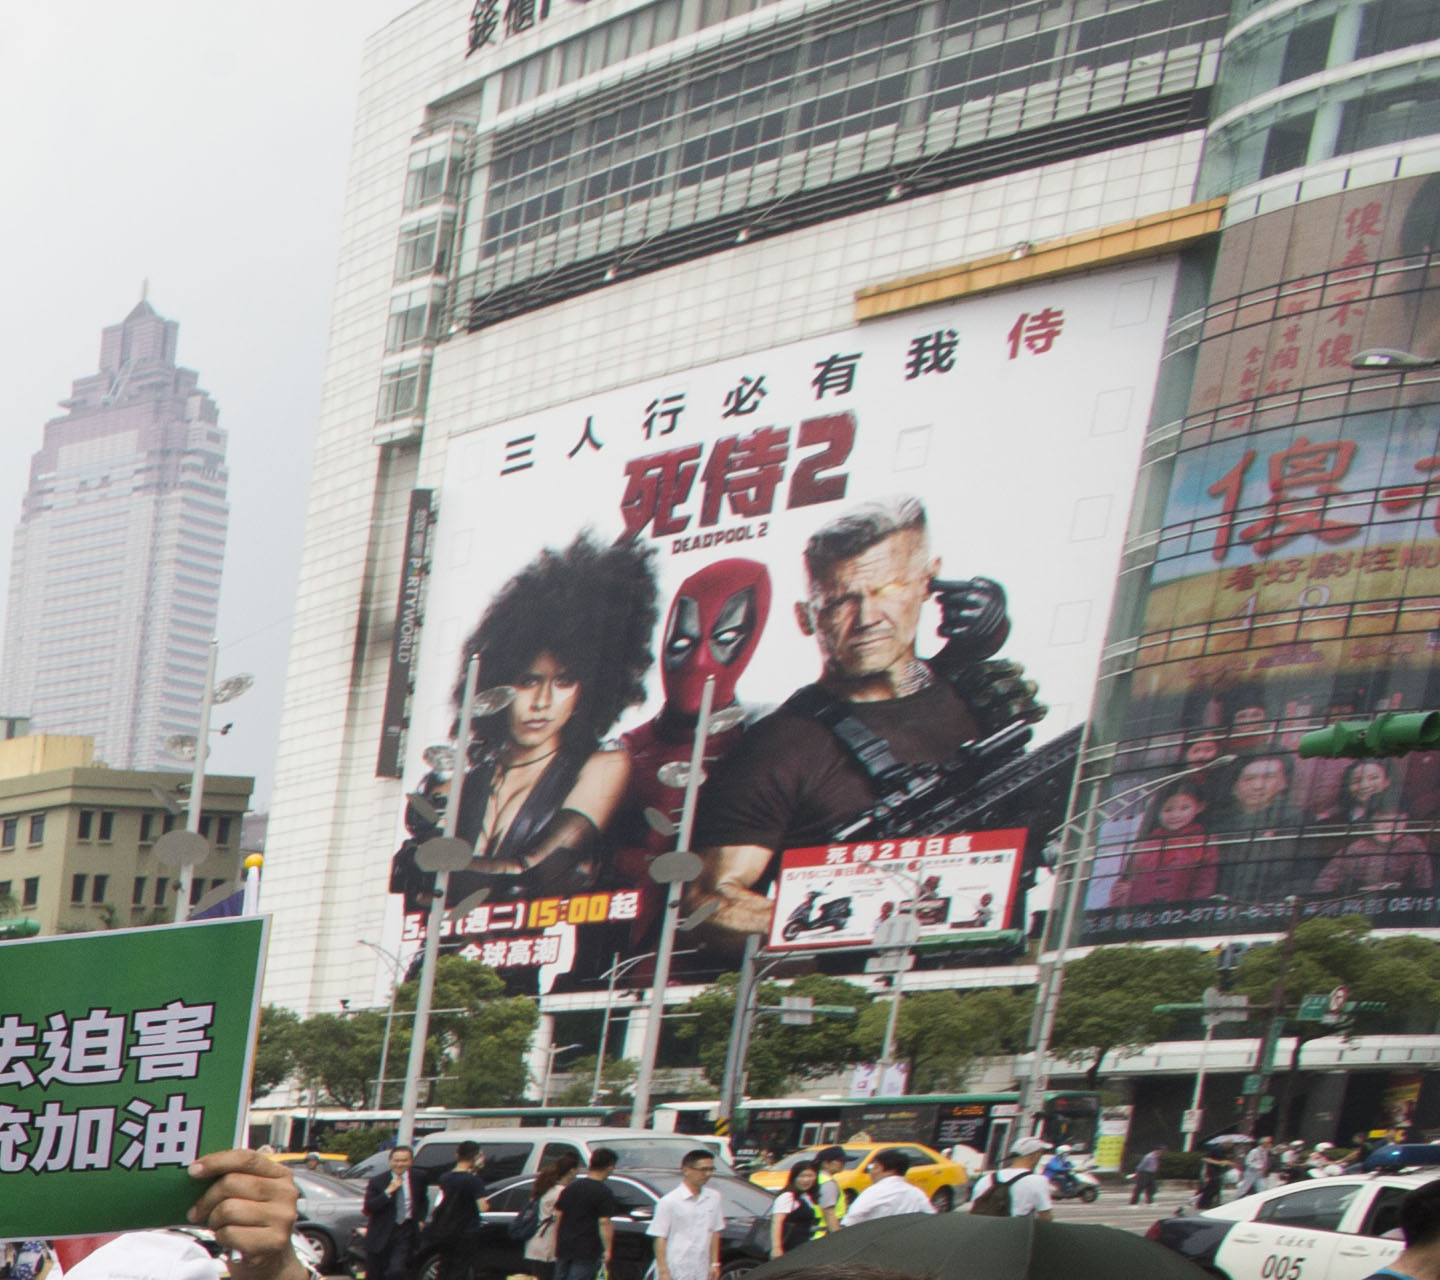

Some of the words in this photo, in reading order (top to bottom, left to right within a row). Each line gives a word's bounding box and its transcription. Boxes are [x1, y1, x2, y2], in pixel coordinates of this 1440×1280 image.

[500, 307, 1067, 476] 三人行必有我侍
[616, 407, 858, 543] 死侍2
[672, 526, 753, 557] DEADPOOL
[756, 520, 769, 540] 2
